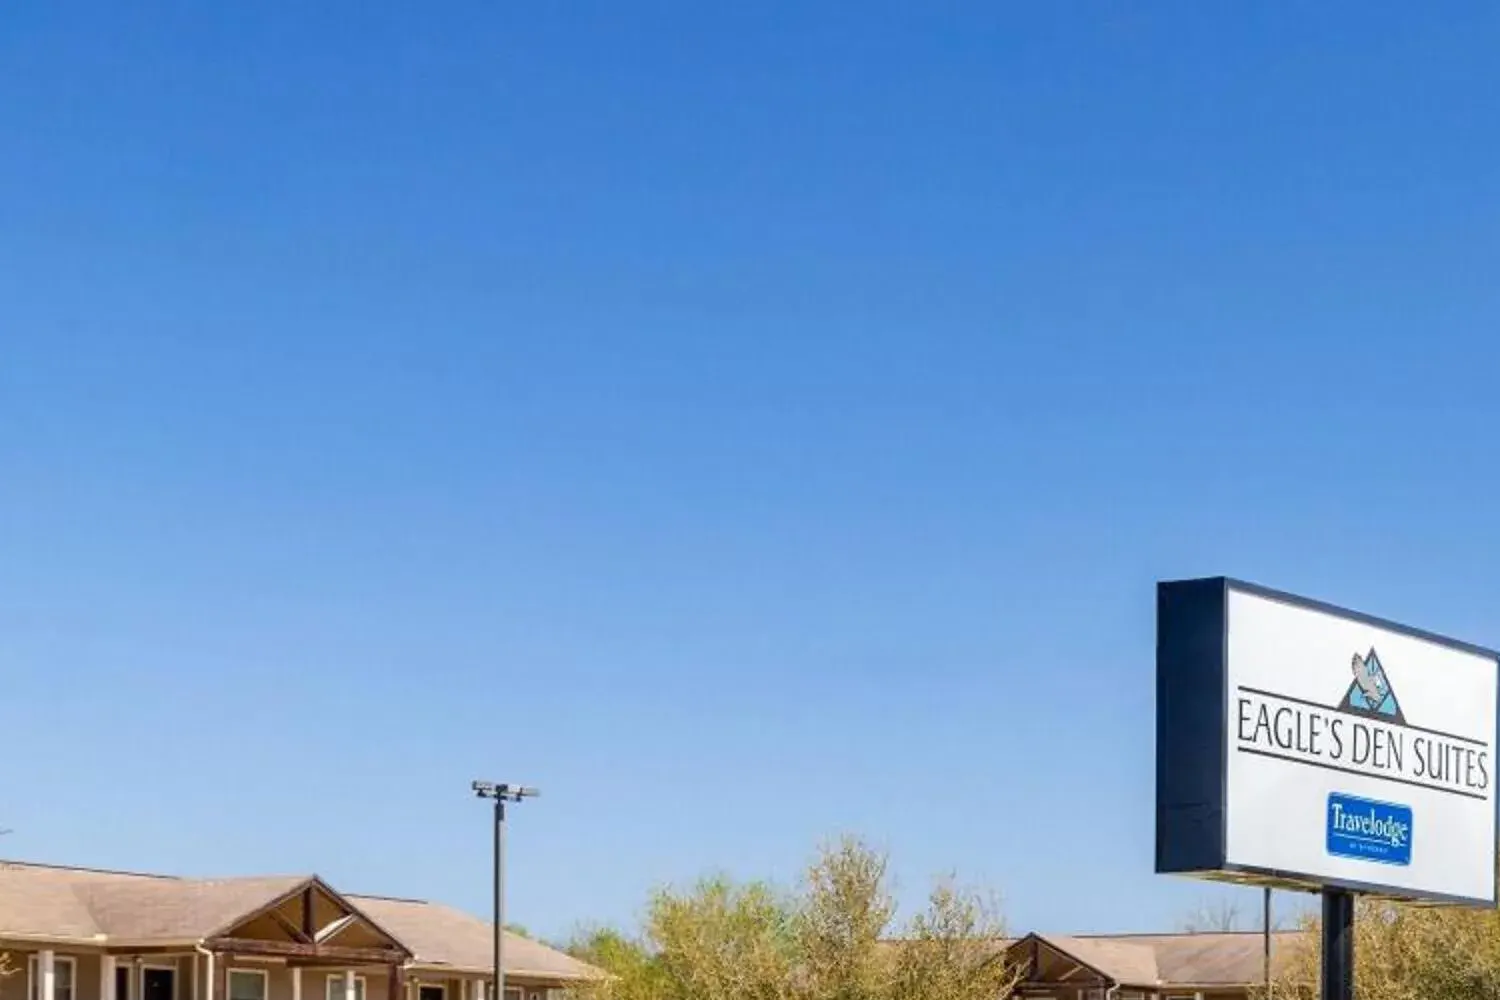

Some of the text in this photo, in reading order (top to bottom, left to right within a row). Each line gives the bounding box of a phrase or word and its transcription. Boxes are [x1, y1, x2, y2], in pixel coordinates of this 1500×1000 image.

[1237, 699, 1489, 789] EAGLE'S DEN SUITES
[1331, 803, 1409, 848] Travelodge
